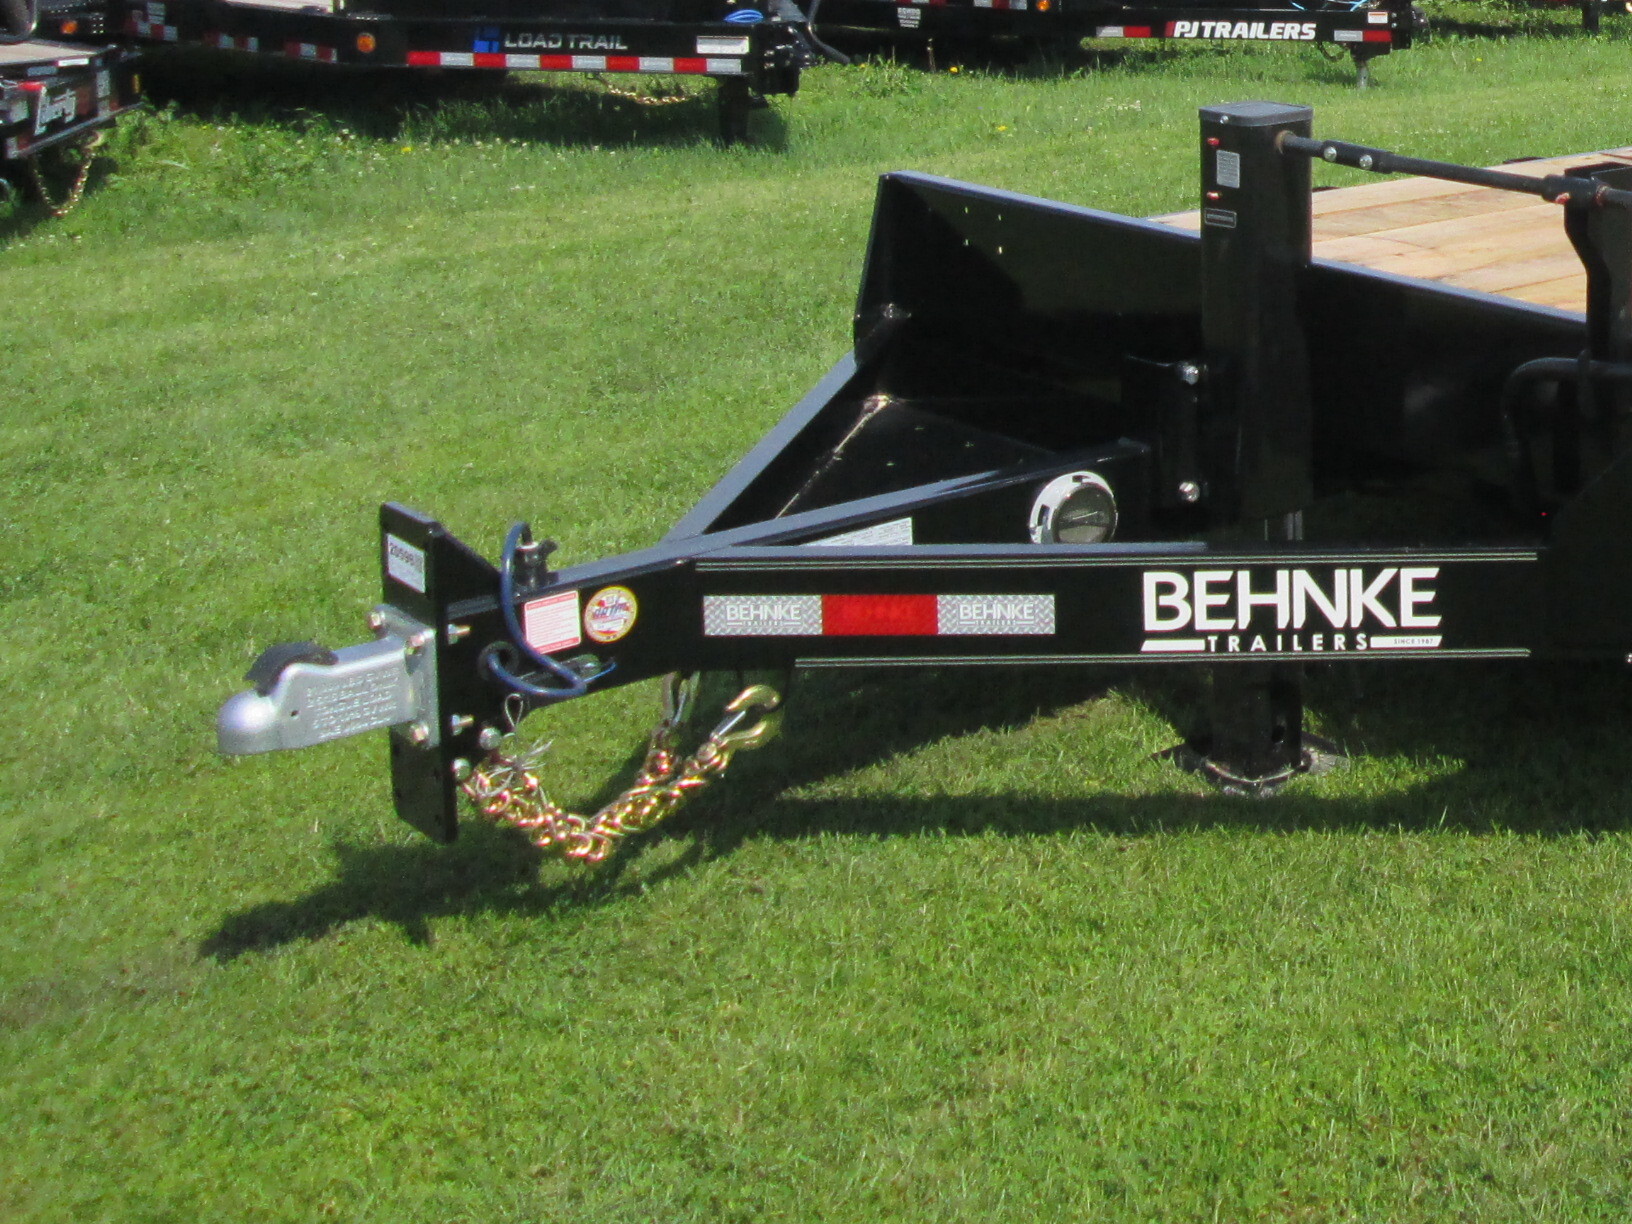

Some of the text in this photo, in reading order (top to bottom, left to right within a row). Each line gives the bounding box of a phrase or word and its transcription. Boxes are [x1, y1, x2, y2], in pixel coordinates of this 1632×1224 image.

[1173, 21, 1317, 40] PJ TRAILERS
[503, 33, 628, 50] LOAD TRAIL
[1143, 567, 1442, 631] BEHNKE
[727, 604, 801, 621] BEHNKE
[960, 603, 1034, 620] BEHNKE
[1206, 633, 1368, 653] TRAILERS
